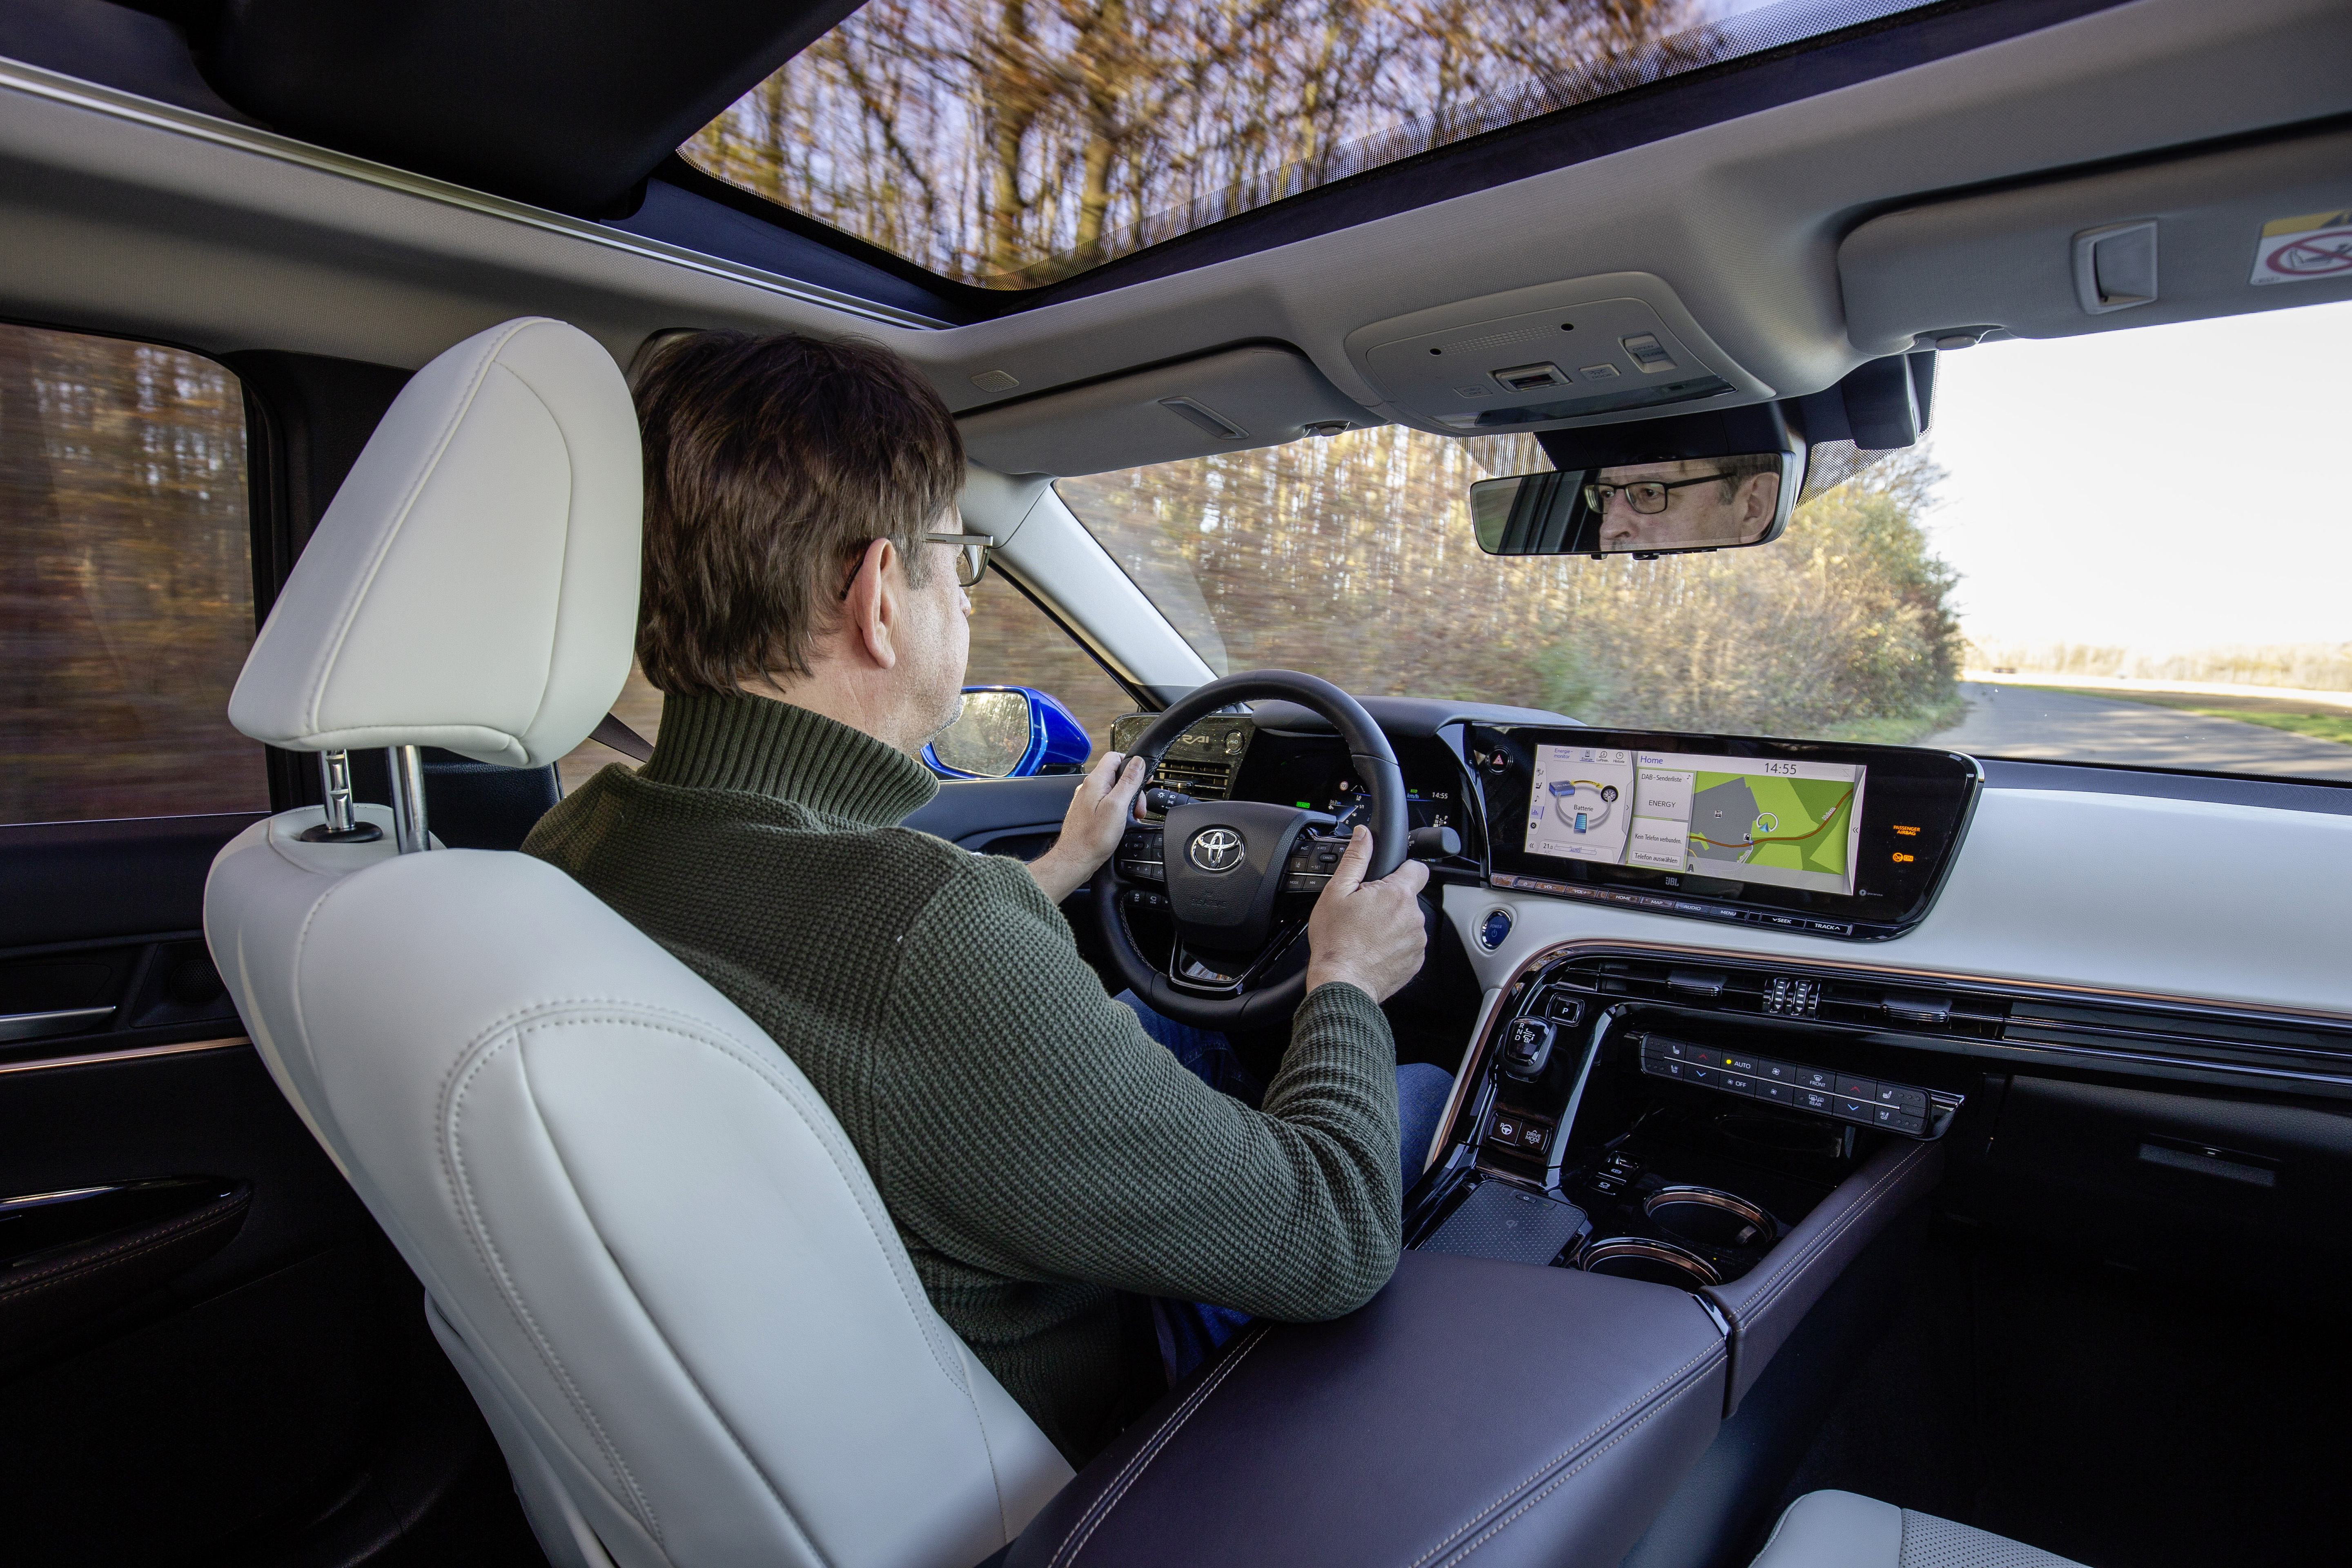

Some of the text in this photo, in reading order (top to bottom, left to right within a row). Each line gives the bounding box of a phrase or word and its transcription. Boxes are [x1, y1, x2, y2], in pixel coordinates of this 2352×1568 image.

[1642, 350, 1664, 358] CLOSE
[1640, 755, 1663, 764] Home
[1765, 762, 1797, 775] 14:55
[1641, 773, 1682, 782] DAB-Senderliste
[1648, 800, 1676, 808] ENERGY
[1660, 836, 1682, 844] verbunden.
[1635, 852, 1678, 864] Telefon auswählen
[1666, 876, 1679, 886] JBL
[1526, 1131, 1541, 1139] DRIVE
